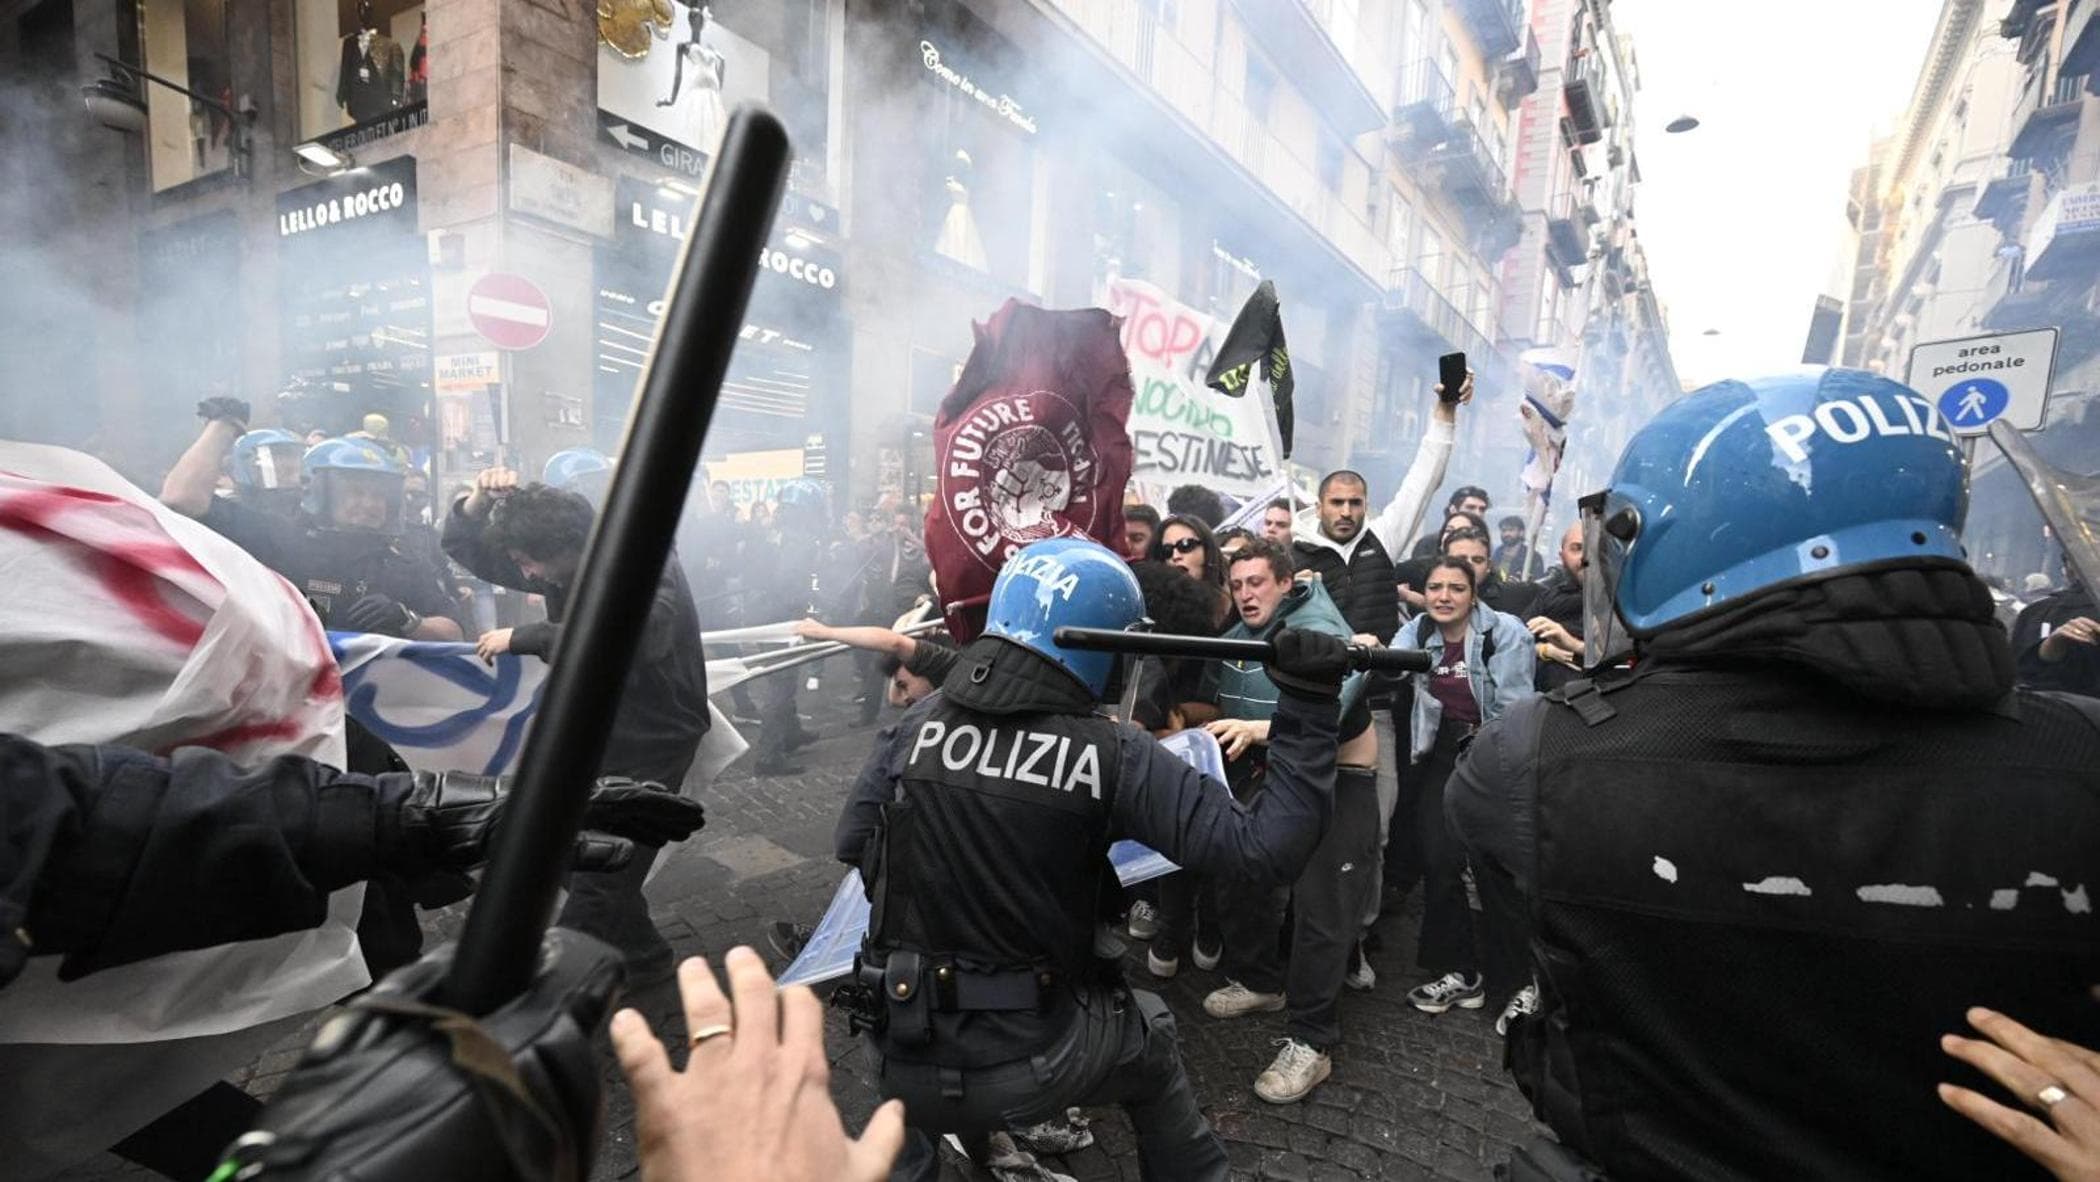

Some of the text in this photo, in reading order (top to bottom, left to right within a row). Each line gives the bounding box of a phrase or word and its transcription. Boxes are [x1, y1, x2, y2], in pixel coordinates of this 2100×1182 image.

[343, 182, 404, 220] ROCCO
[632, 202, 685, 240] LEL
[1932, 356, 2026, 378] pedonale
[1958, 343, 2001, 358] area
[951, 399, 1035, 479] FUTURE
[1134, 429, 1272, 481] ESTINESE
[951, 486, 1001, 556] FOR
[908, 720, 1102, 801] POLIZIA
